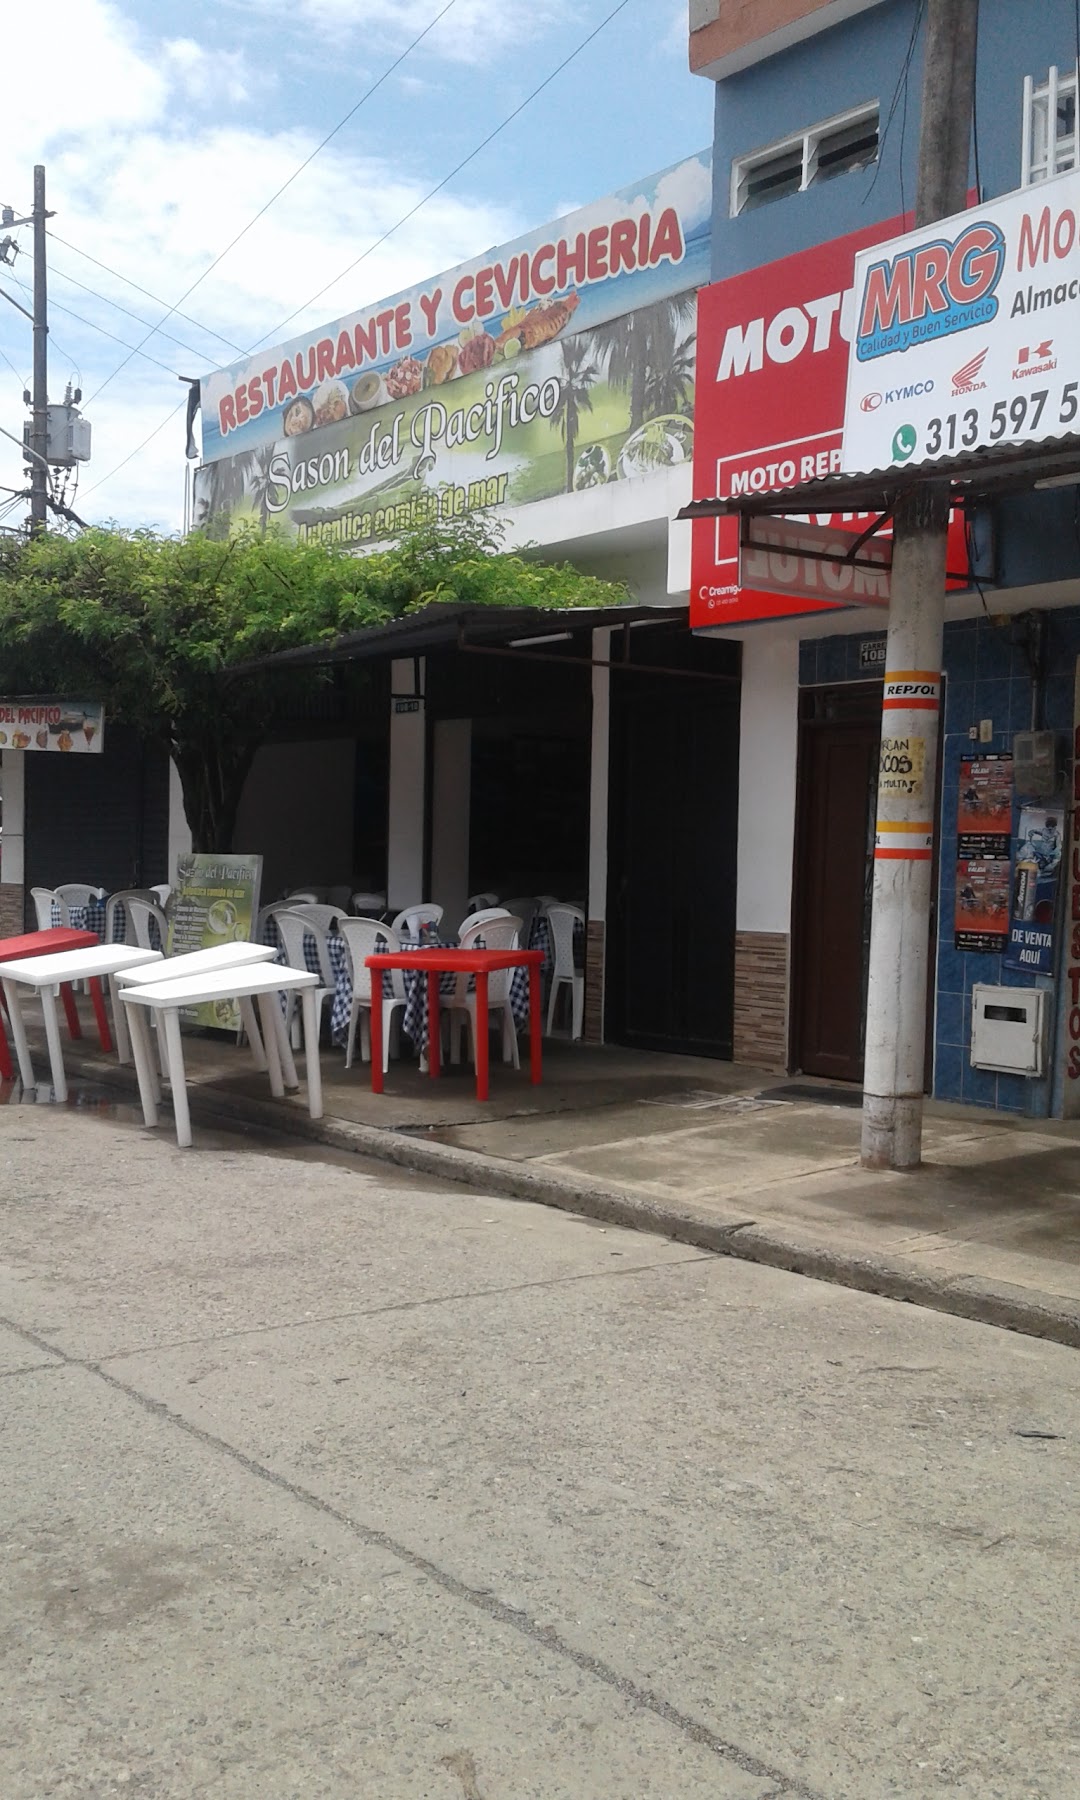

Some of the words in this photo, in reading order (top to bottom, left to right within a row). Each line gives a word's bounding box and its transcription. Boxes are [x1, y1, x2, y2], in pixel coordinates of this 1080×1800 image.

[1017, 205, 1080, 272] MO
[860, 228, 999, 337] MRG
[1010, 279, 1080, 319] Almac
[218, 303, 412, 435] RESTAURANTE
[420, 295, 443, 337] Y
[451, 208, 684, 324] CEVICHERIA
[860, 332, 900, 355] Calidad
[902, 332, 910, 345] y
[913, 321, 940, 338] Buen
[944, 304, 994, 328] Servicio
[1012, 358, 1058, 380] Kawasaki
[885, 380, 935, 404] KYMCO
[951, 381, 988, 397] HONDA
[925, 408, 979, 455] 313
[990, 390, 1049, 440] 597
[1059, 382, 1079, 423] 5
[265, 446, 350, 514] Sason
[359, 420, 402, 473] del
[411, 373, 562, 481] Pacifico
[731, 460, 796, 494] MOTO
[442, 482, 466, 520] de
[468, 472, 509, 512] mar
[862, 650, 886, 661] 10B
[888, 685, 935, 695] REPSOL
[18, 706, 62, 725] PACIFICO
[1012, 929, 1024, 942] DE
[1024, 931, 1051, 947] VENTA
[1019, 949, 1041, 964] AQUÍ
